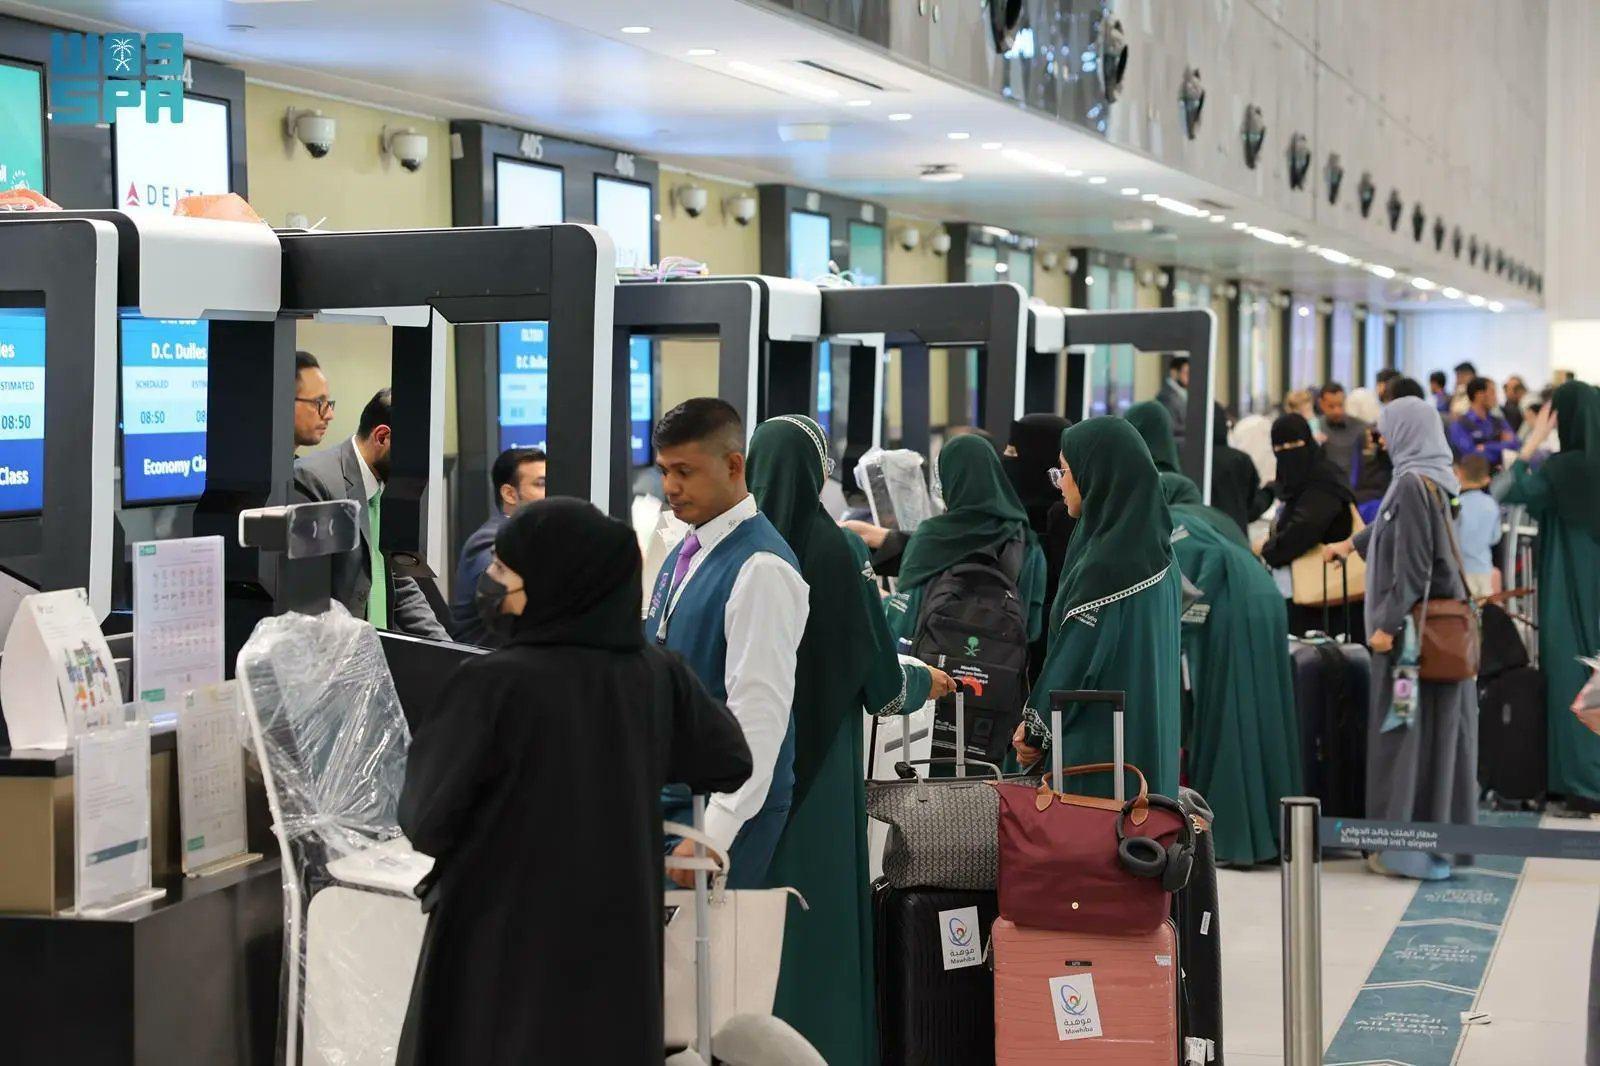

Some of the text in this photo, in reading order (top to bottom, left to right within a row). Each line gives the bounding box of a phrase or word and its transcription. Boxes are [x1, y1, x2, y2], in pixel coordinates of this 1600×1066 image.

[151, 342, 173, 360] D.C.
[1, 415, 31, 430] 08:50
[140, 411, 165, 425] 08:50
[143, 455, 206, 477] Economy Cla
[950, 956, 976, 965] Mawhiba
[1063, 1017, 1093, 1028] موهبة
[1064, 1026, 1094, 1035] Mawhiba
